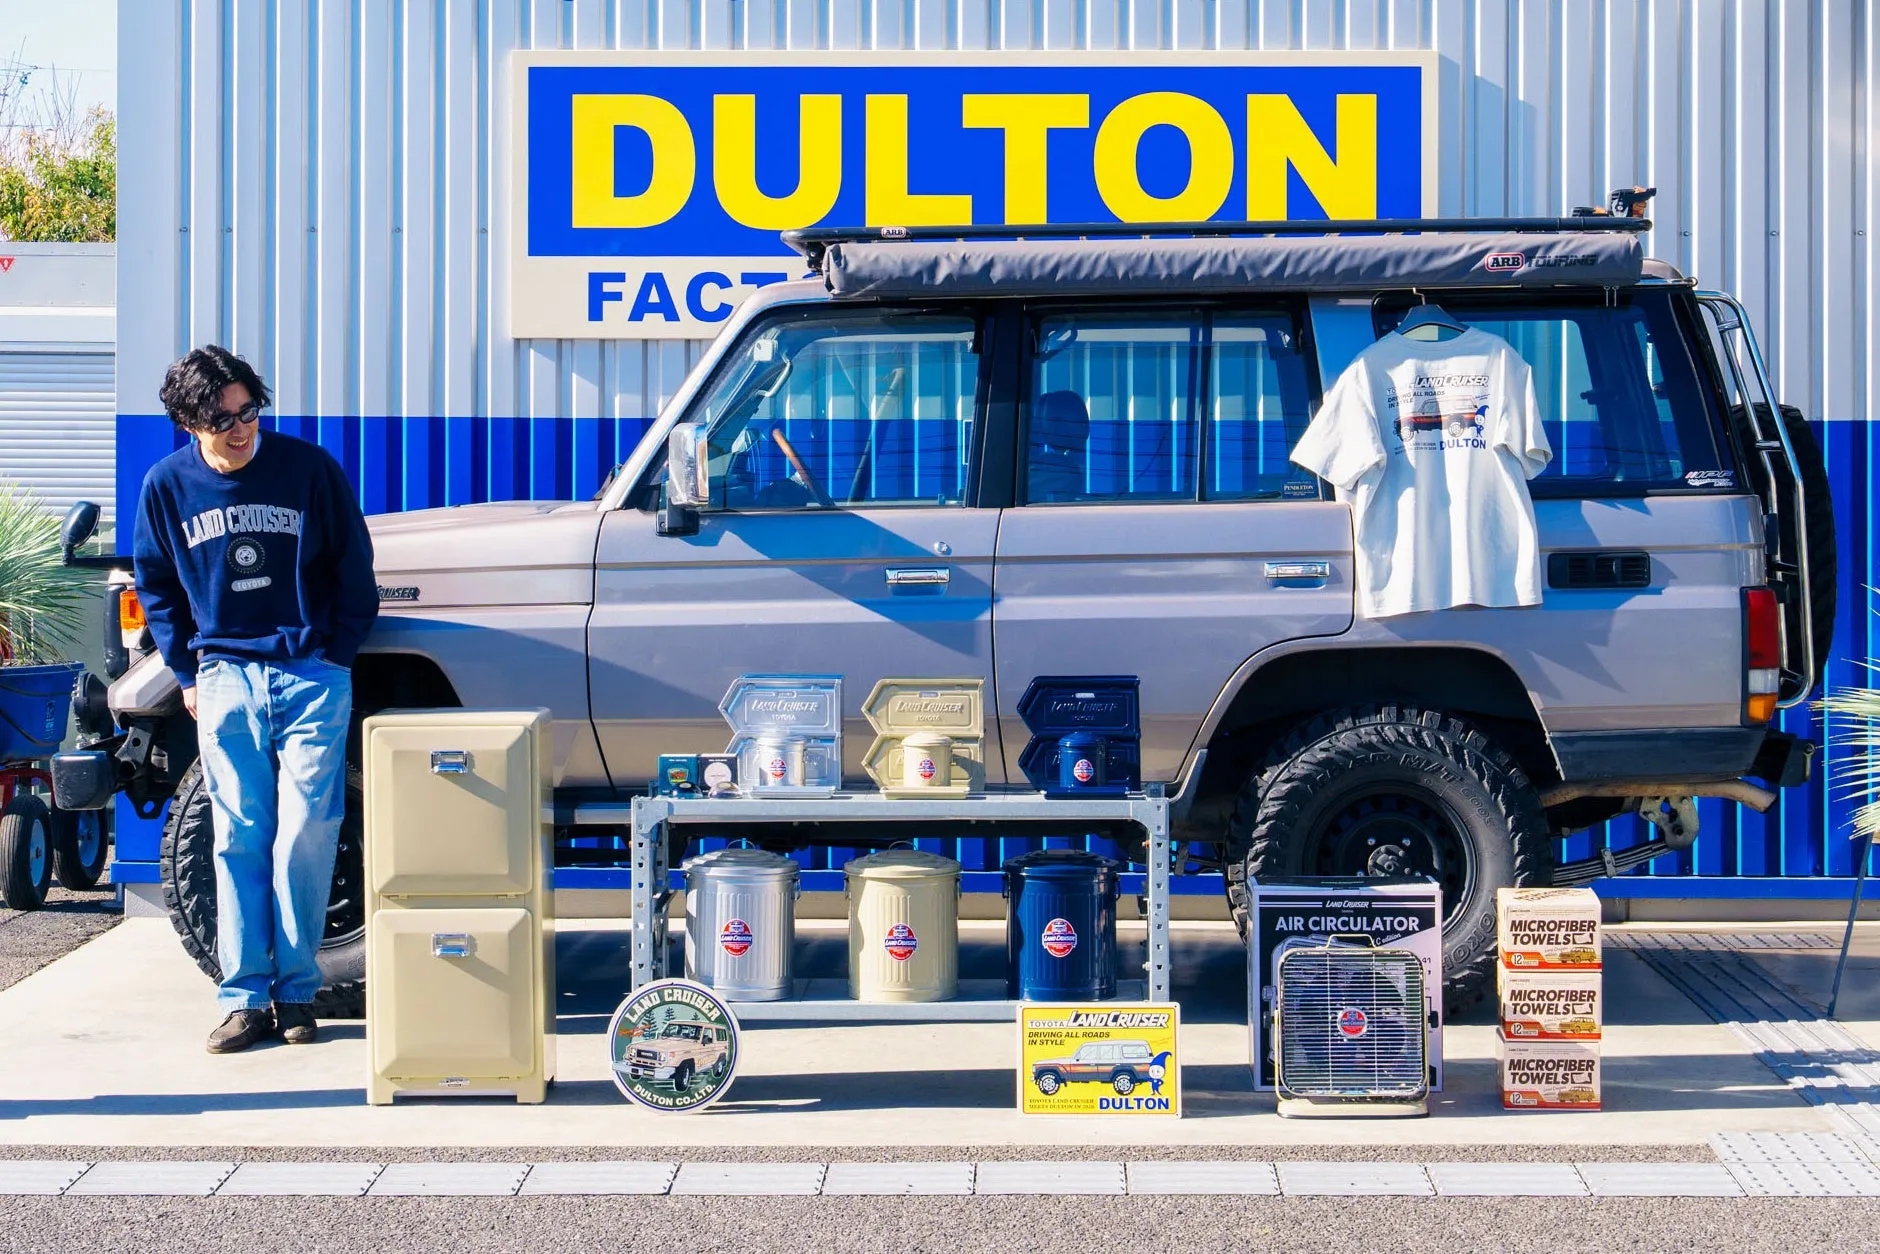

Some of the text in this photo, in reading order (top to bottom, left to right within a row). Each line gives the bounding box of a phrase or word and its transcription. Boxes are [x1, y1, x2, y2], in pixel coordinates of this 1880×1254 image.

[572, 92, 1377, 230] DULTON
[1490, 253, 1597, 268] ARB TOURING
[1440, 438, 1486, 450] DULTON
[182, 504, 301, 549] LAND CRUISER
[237, 580, 267, 590] TOYOTA
[1342, 900, 1369, 908] CRUISER
[1275, 916, 1419, 931] AIR CIRCULATOR
[1510, 920, 1597, 932] MICROFIBER
[1381, 933, 1401, 943] edition
[1512, 933, 1571, 945] TOWELS
[1513, 954, 1523, 964] 12
[1510, 989, 1596, 1002] MICROFIBER
[625, 988, 721, 1023] LAND CRUISER
[1512, 1003, 1571, 1015] TOWELS
[1513, 1024, 1522, 1034] 12
[1508, 1059, 1595, 1071] MICROFIBER
[1510, 1072, 1569, 1084] TOWELS
[634, 1083, 673, 1105] DULTON
[1512, 1093, 1521, 1104] 12
[1100, 1097, 1169, 1110] DULTON
